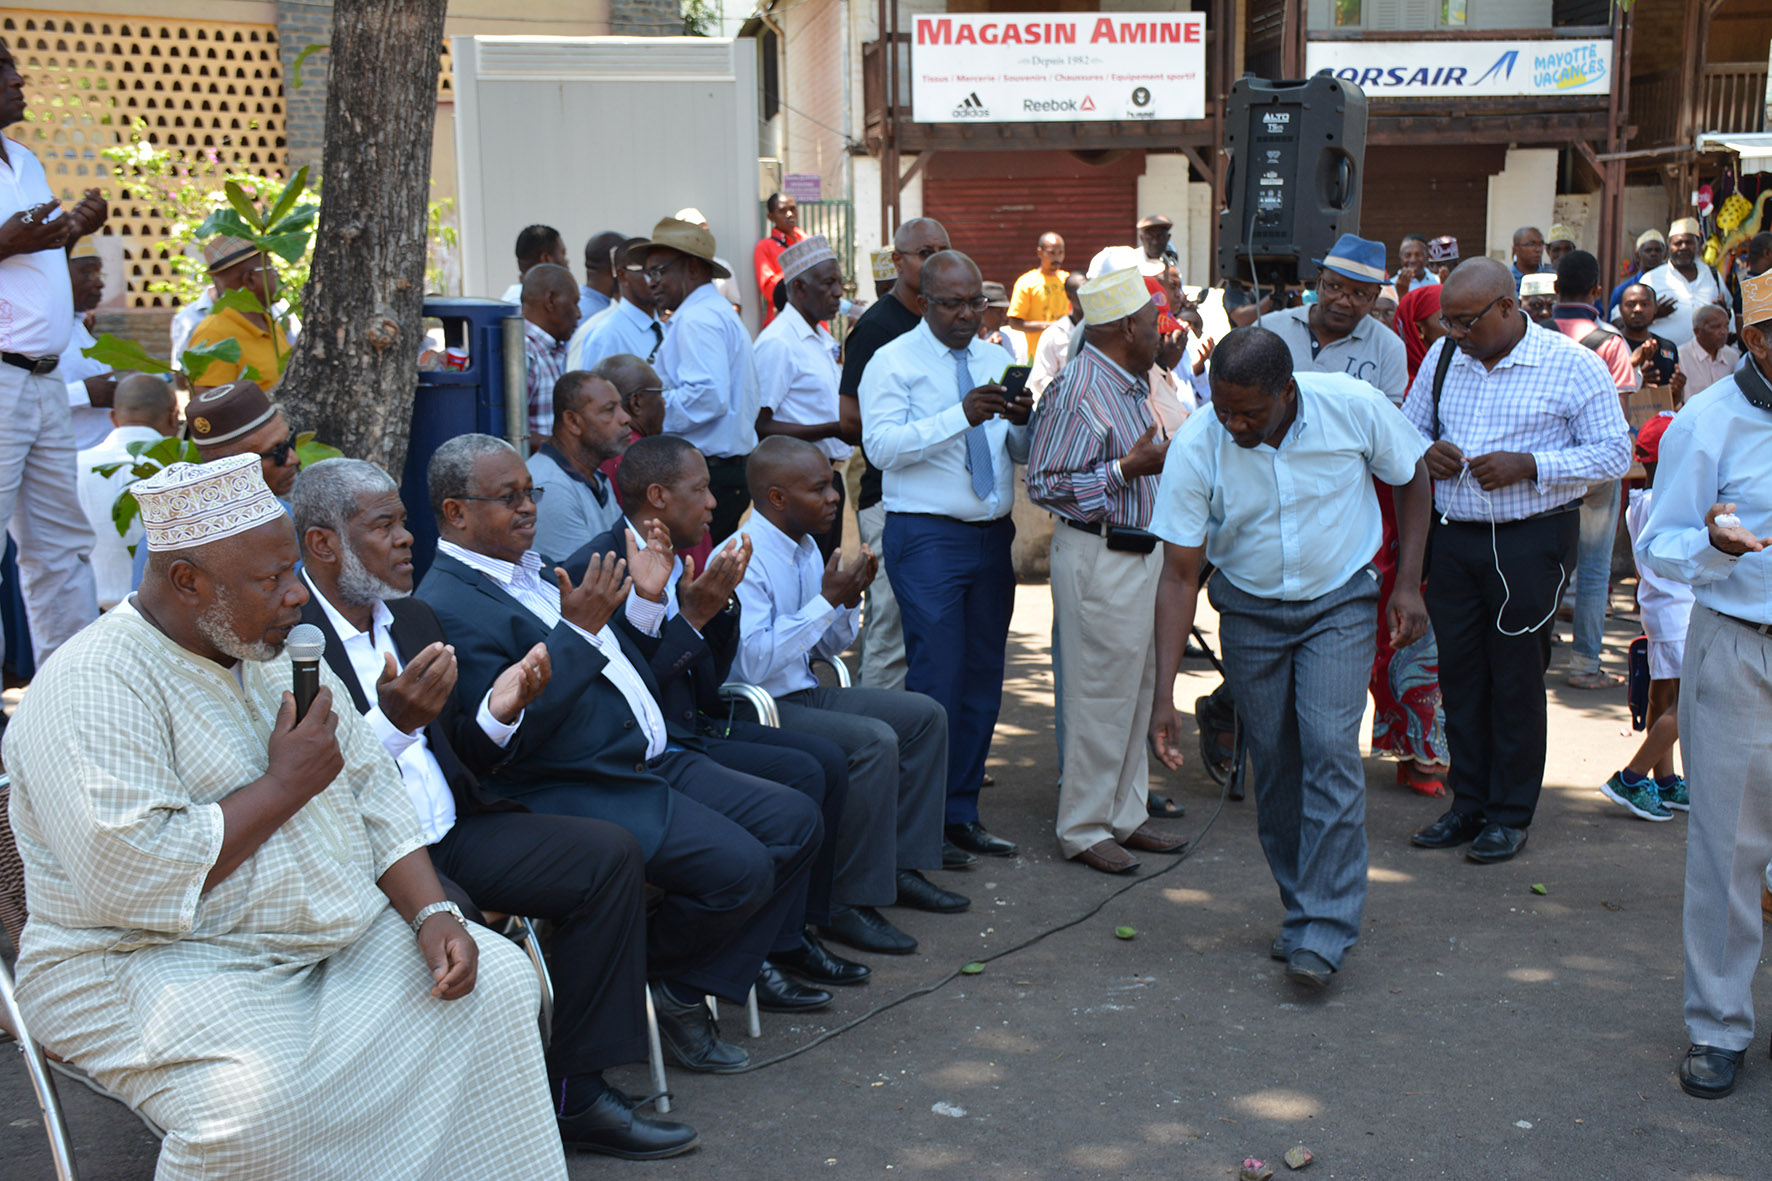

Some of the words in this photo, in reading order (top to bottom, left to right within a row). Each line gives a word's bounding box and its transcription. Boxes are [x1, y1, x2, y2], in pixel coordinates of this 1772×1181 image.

[917, 18, 1077, 46] MAGASIN
[1090, 17, 1201, 44] AMINE
[1032, 55, 1065, 69] Depuis
[1067, 55, 1089, 65] 1982
[1534, 43, 1598, 71] MAYOTTE
[1316, 66, 1468, 86] ORSAIR
[1533, 57, 1605, 88] VACANCES
[952, 109, 990, 118] adidas
[1023, 98, 1077, 112] Reebok
